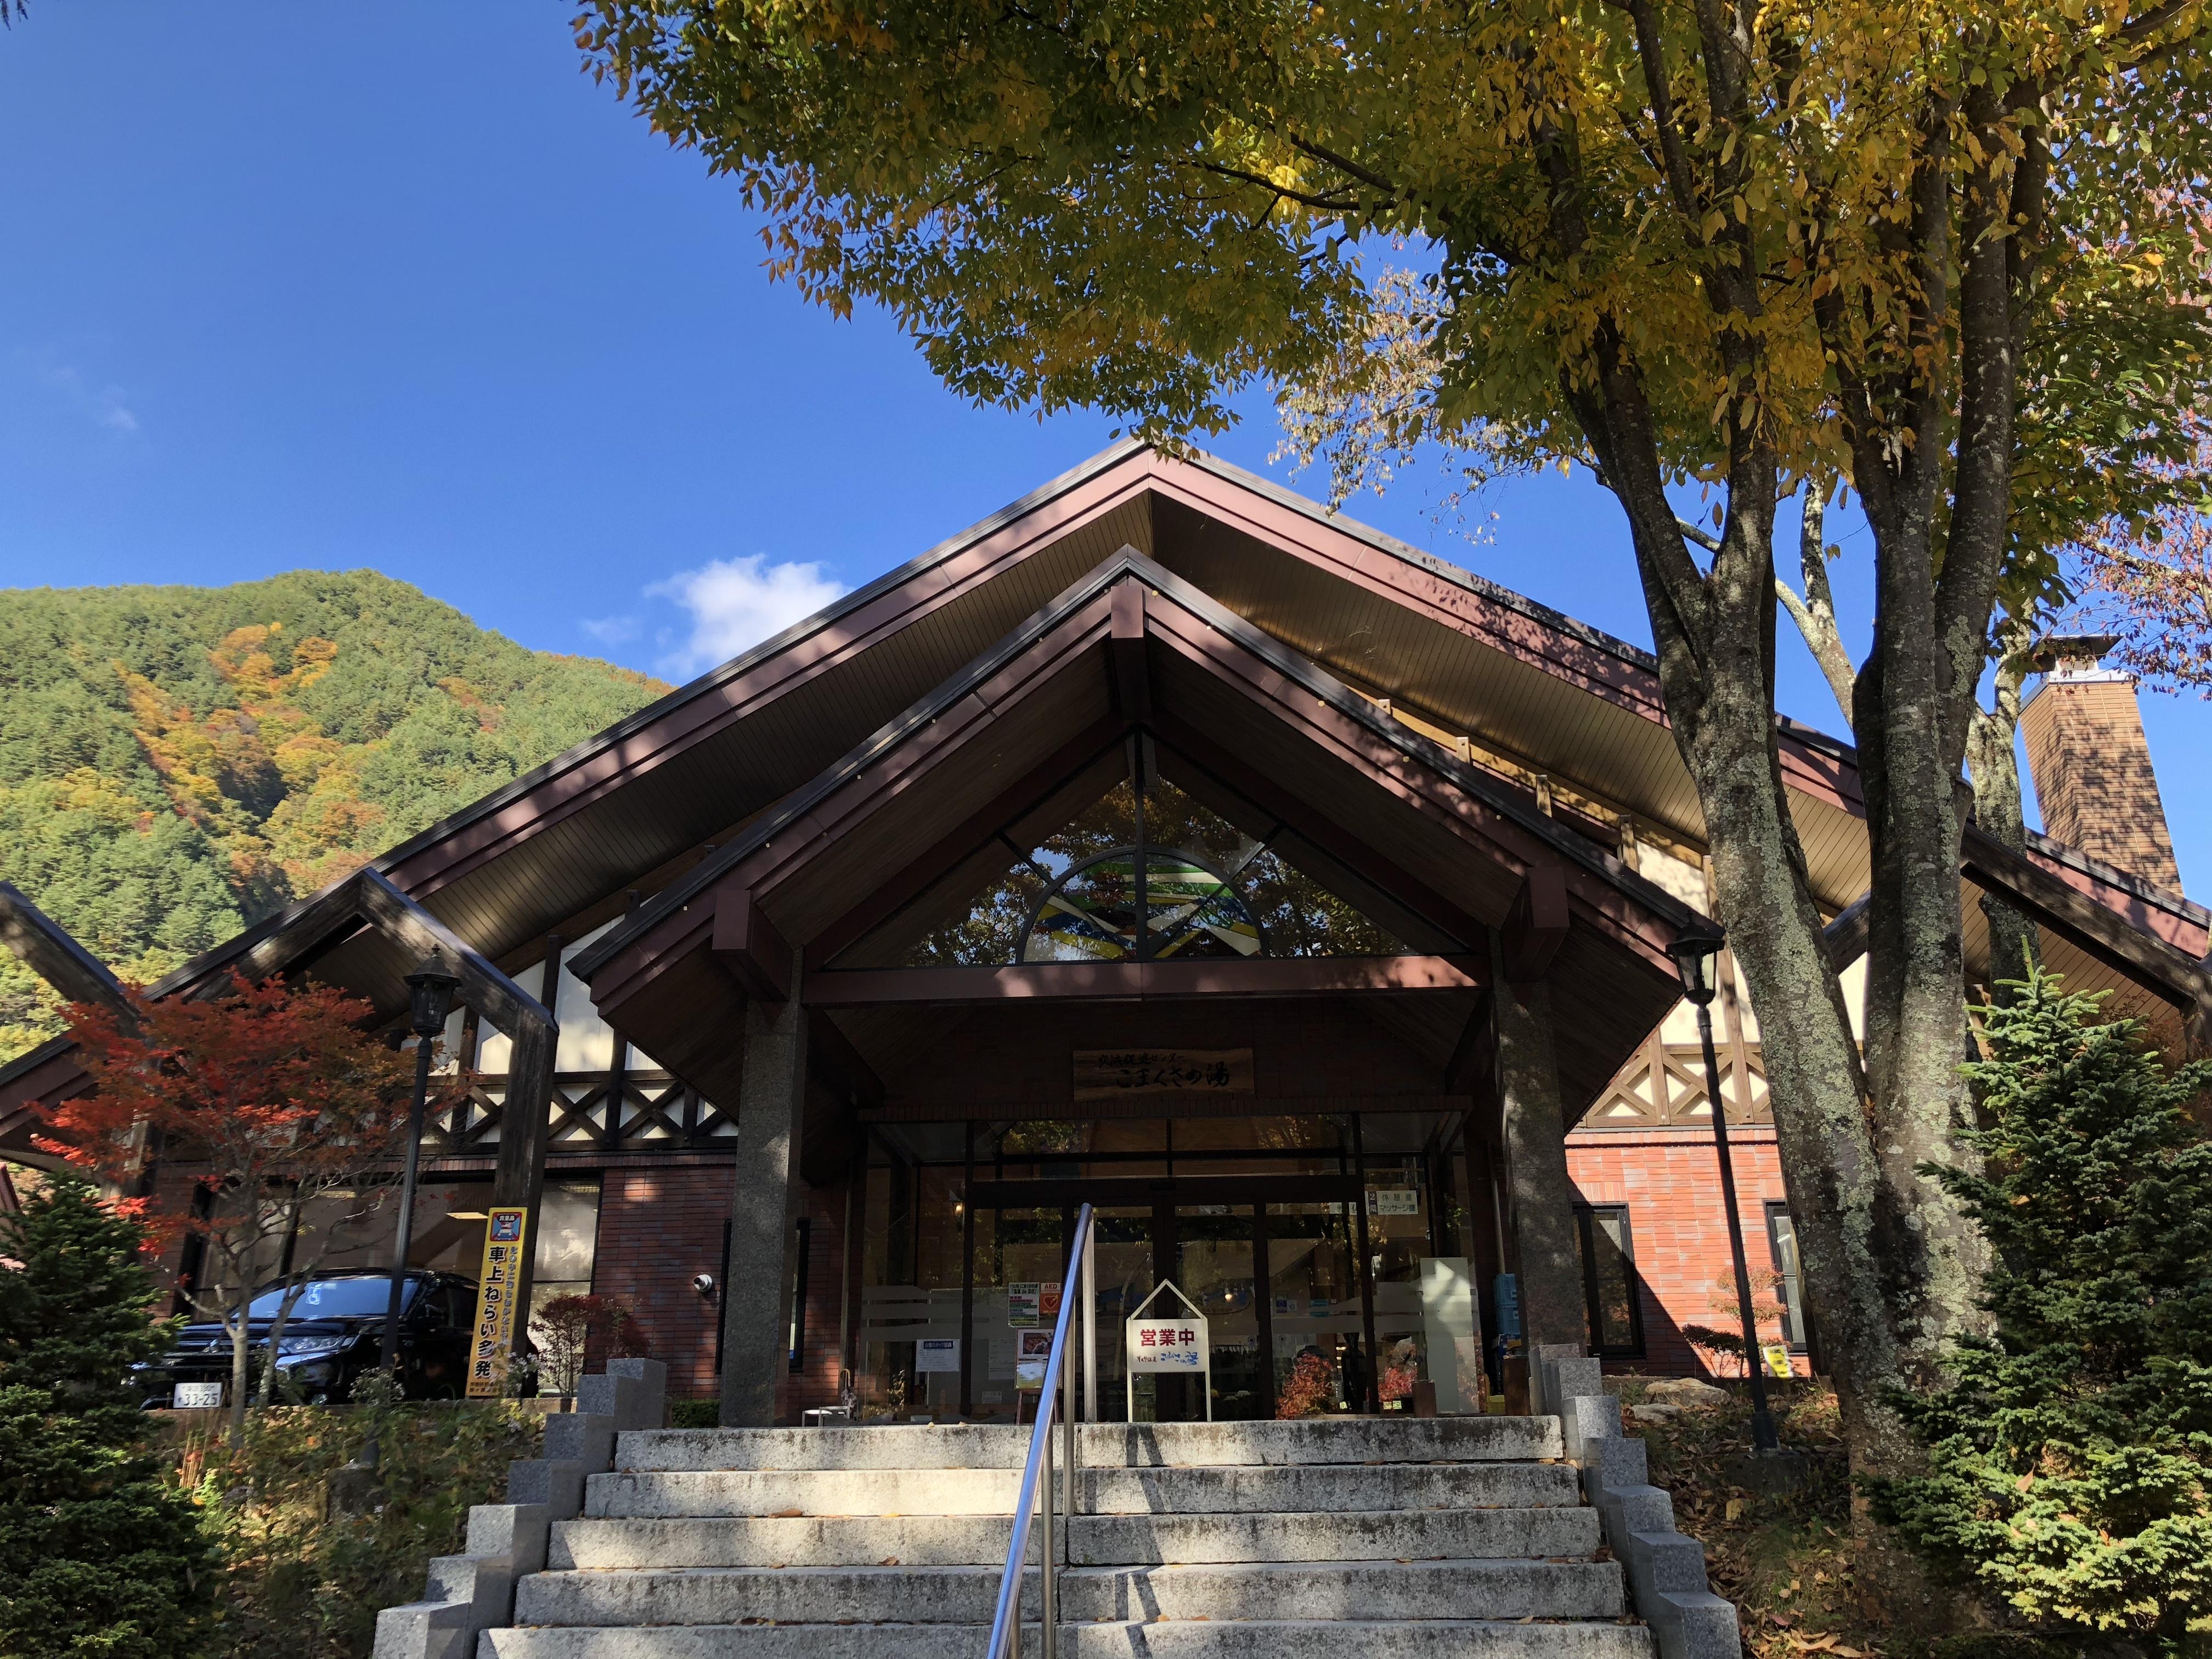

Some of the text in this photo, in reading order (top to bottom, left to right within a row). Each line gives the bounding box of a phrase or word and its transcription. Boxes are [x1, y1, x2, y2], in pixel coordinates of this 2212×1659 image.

[1116, 1062, 1229, 1088] こまくさの湯
[475, 1246, 506, 1379] 車上ねらい多発
[1141, 1328, 1194, 1346] 営業中
